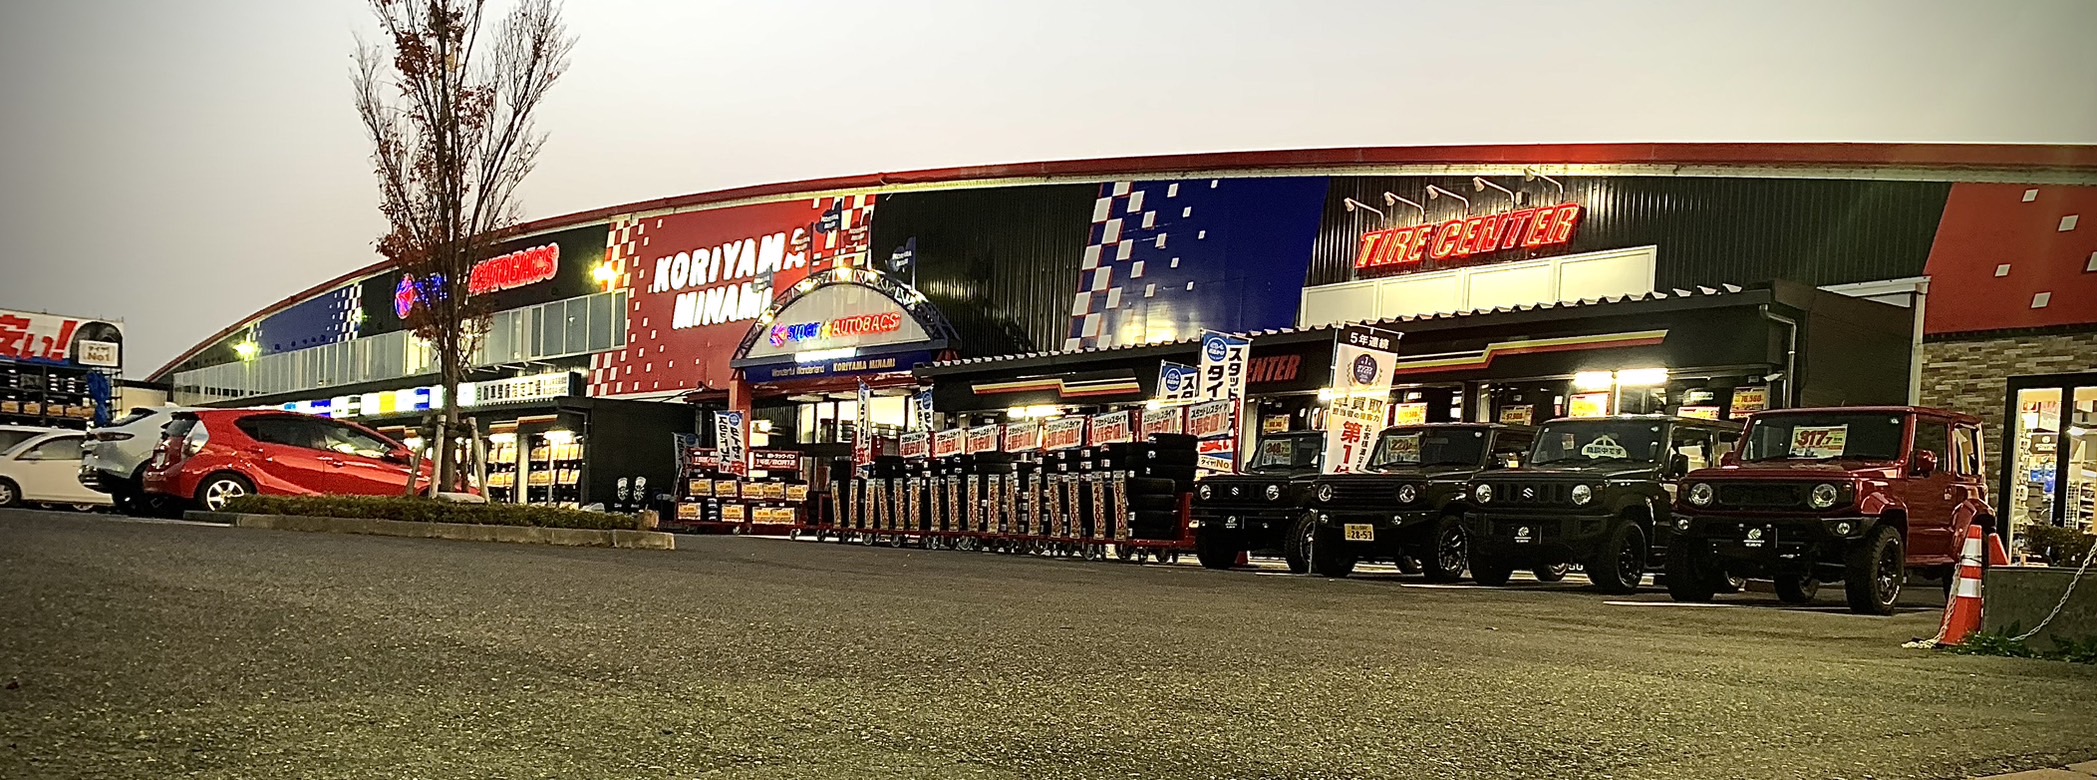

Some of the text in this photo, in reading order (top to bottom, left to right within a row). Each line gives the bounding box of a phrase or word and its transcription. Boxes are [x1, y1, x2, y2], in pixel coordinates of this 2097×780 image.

[1355, 203, 1580, 268] TIRE CENTER
[653, 227, 806, 294] KORIYAMA
[672, 280, 773, 330] MINAMI
[831, 312, 901, 337] AUTOBACS
[1349, 331, 1390, 350] 5年連続
[833, 359, 867, 373] KORIYAMA
[869, 356, 896, 370] MINAMI
[1246, 356, 1302, 383] ENTER
[1796, 430, 1833, 446] 317.7
